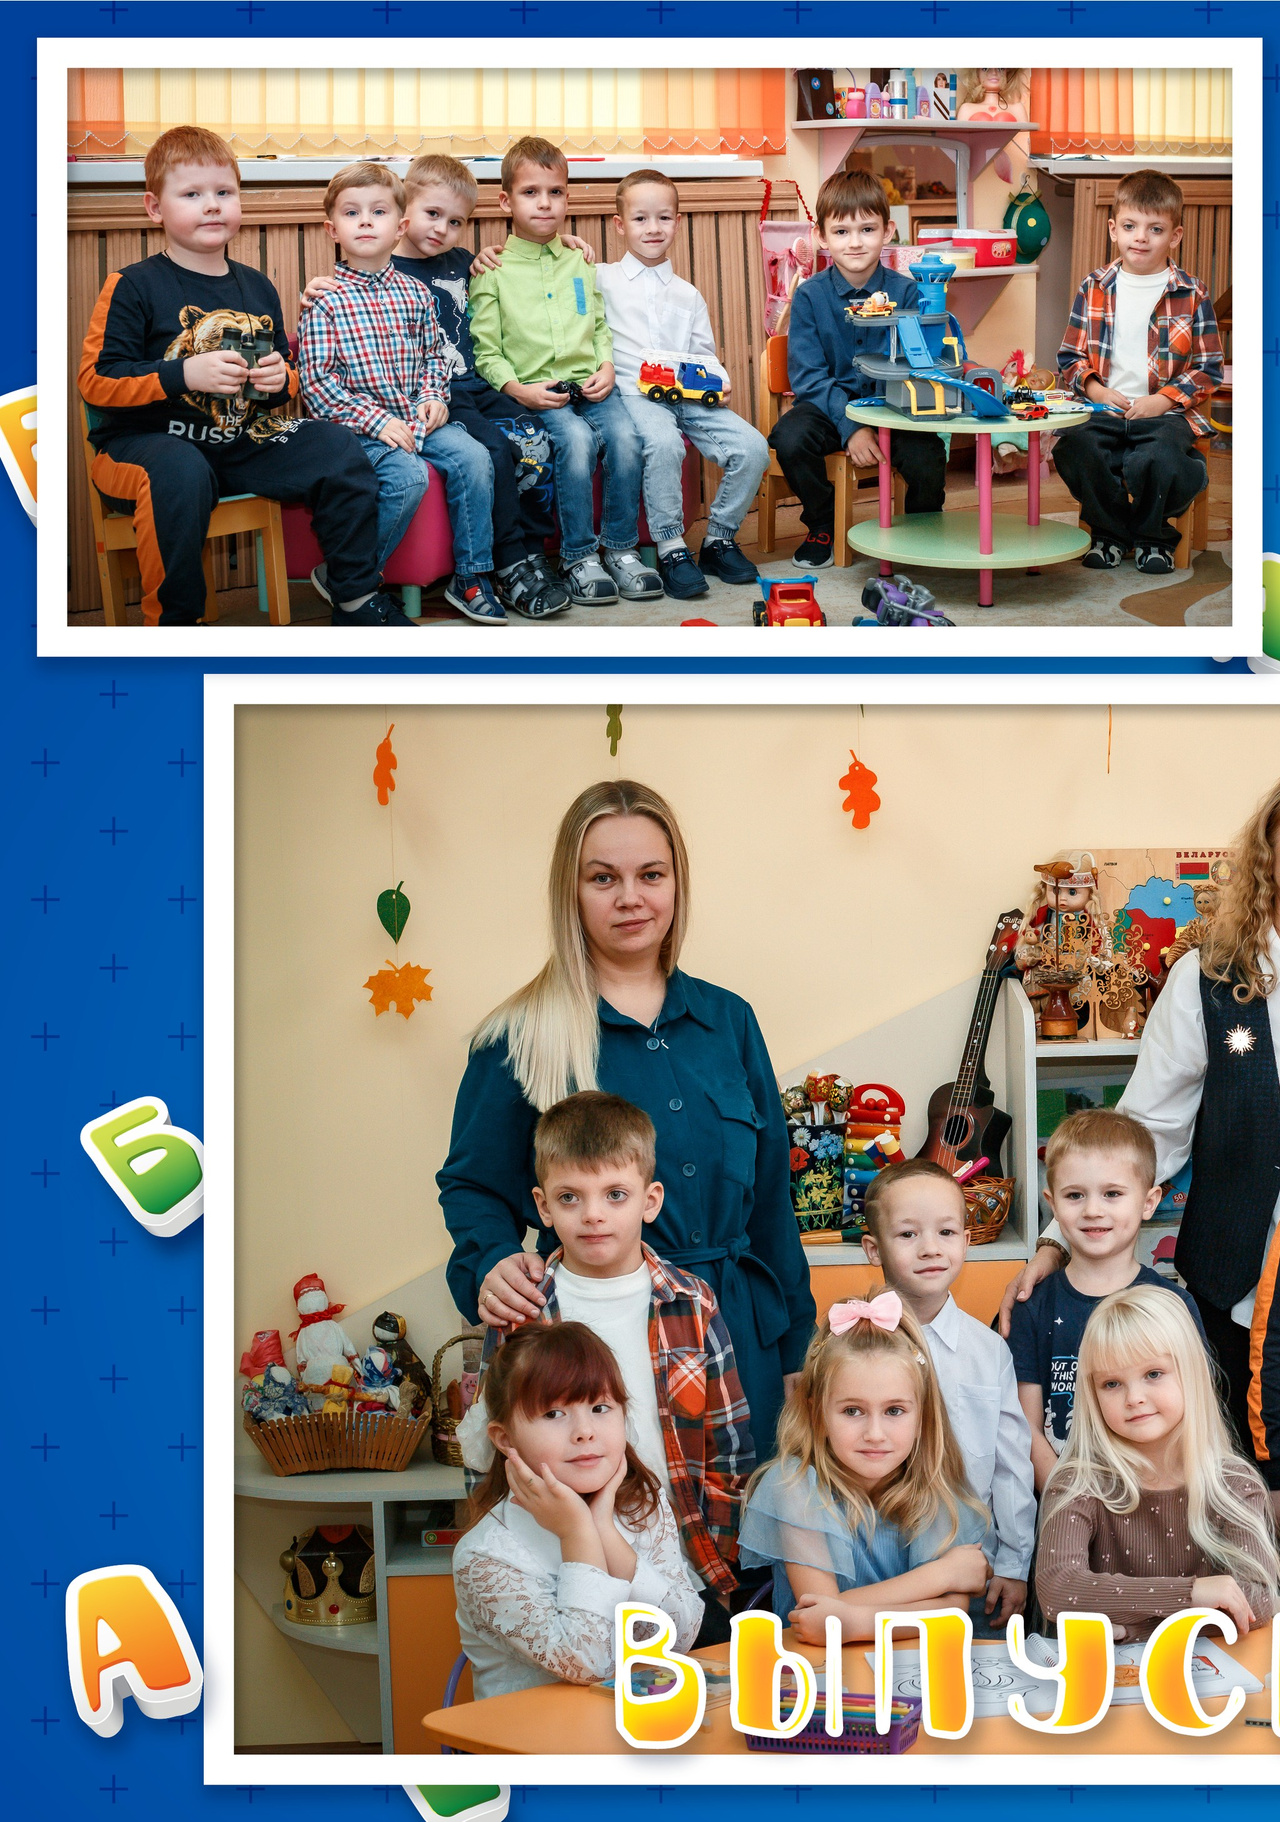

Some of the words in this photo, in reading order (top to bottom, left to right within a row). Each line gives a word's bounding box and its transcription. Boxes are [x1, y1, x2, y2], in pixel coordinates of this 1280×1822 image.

[218, 415, 242, 426] THE
[1002, 916, 1023, 925] Guita
[1174, 1192, 1184, 1202] 50
[1053, 1371, 1074, 1380] THIS
[1051, 1382, 1076, 1391] WORL
